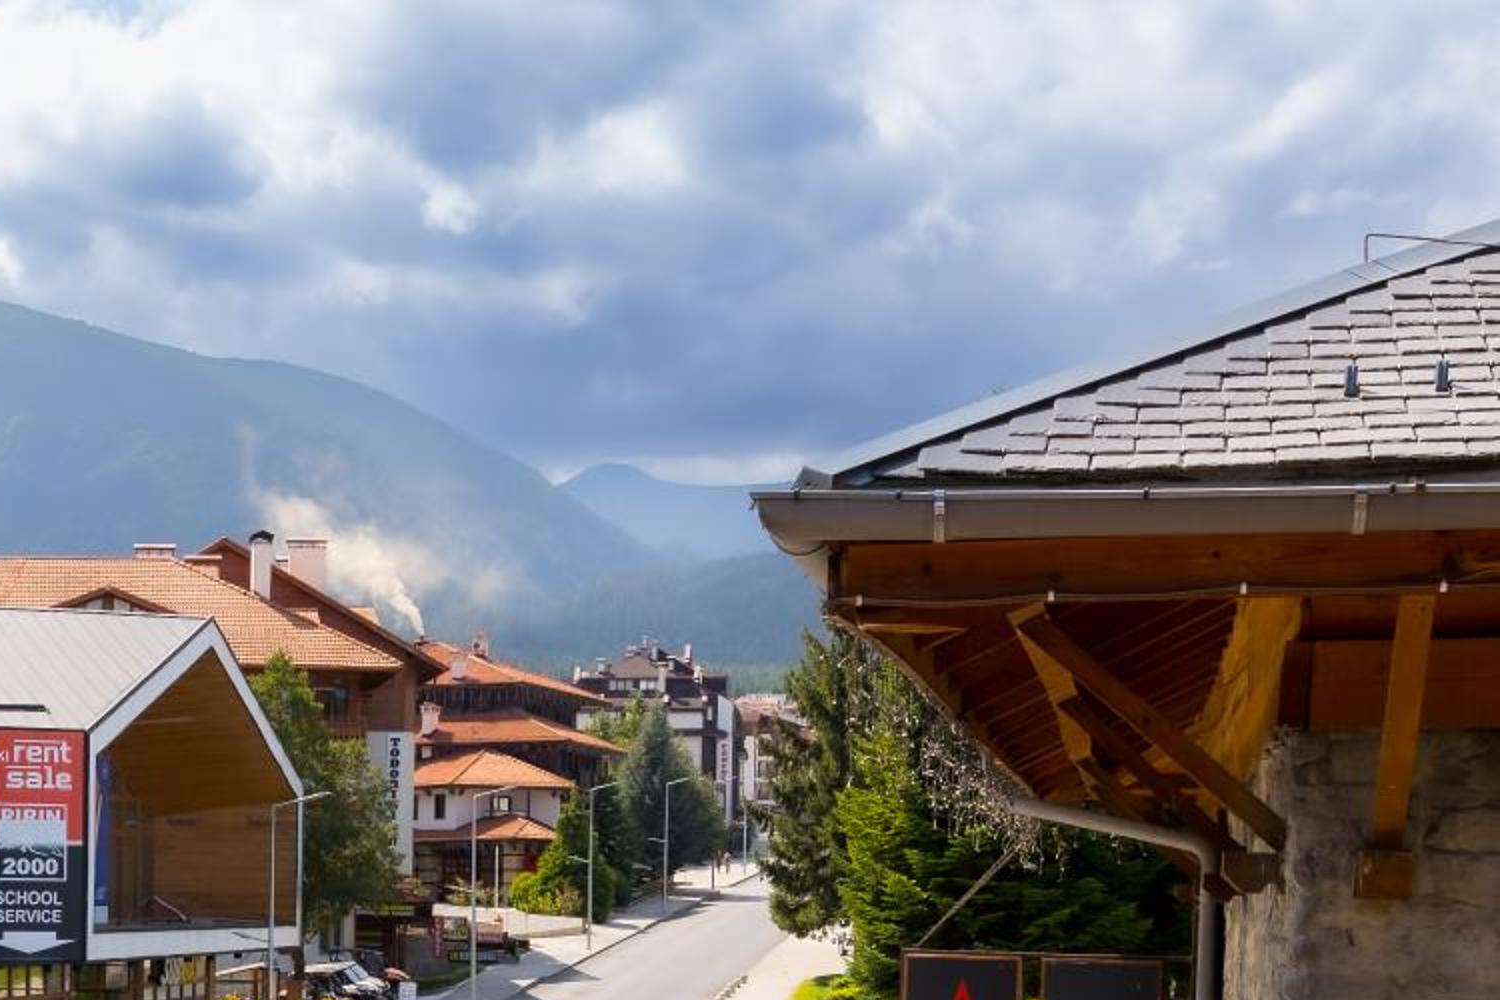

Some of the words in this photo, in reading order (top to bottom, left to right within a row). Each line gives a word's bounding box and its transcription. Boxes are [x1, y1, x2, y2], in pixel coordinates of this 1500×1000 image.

[13, 739, 72, 764] rent
[6, 766, 72, 790] sale
[2, 857, 59, 875] 2000
